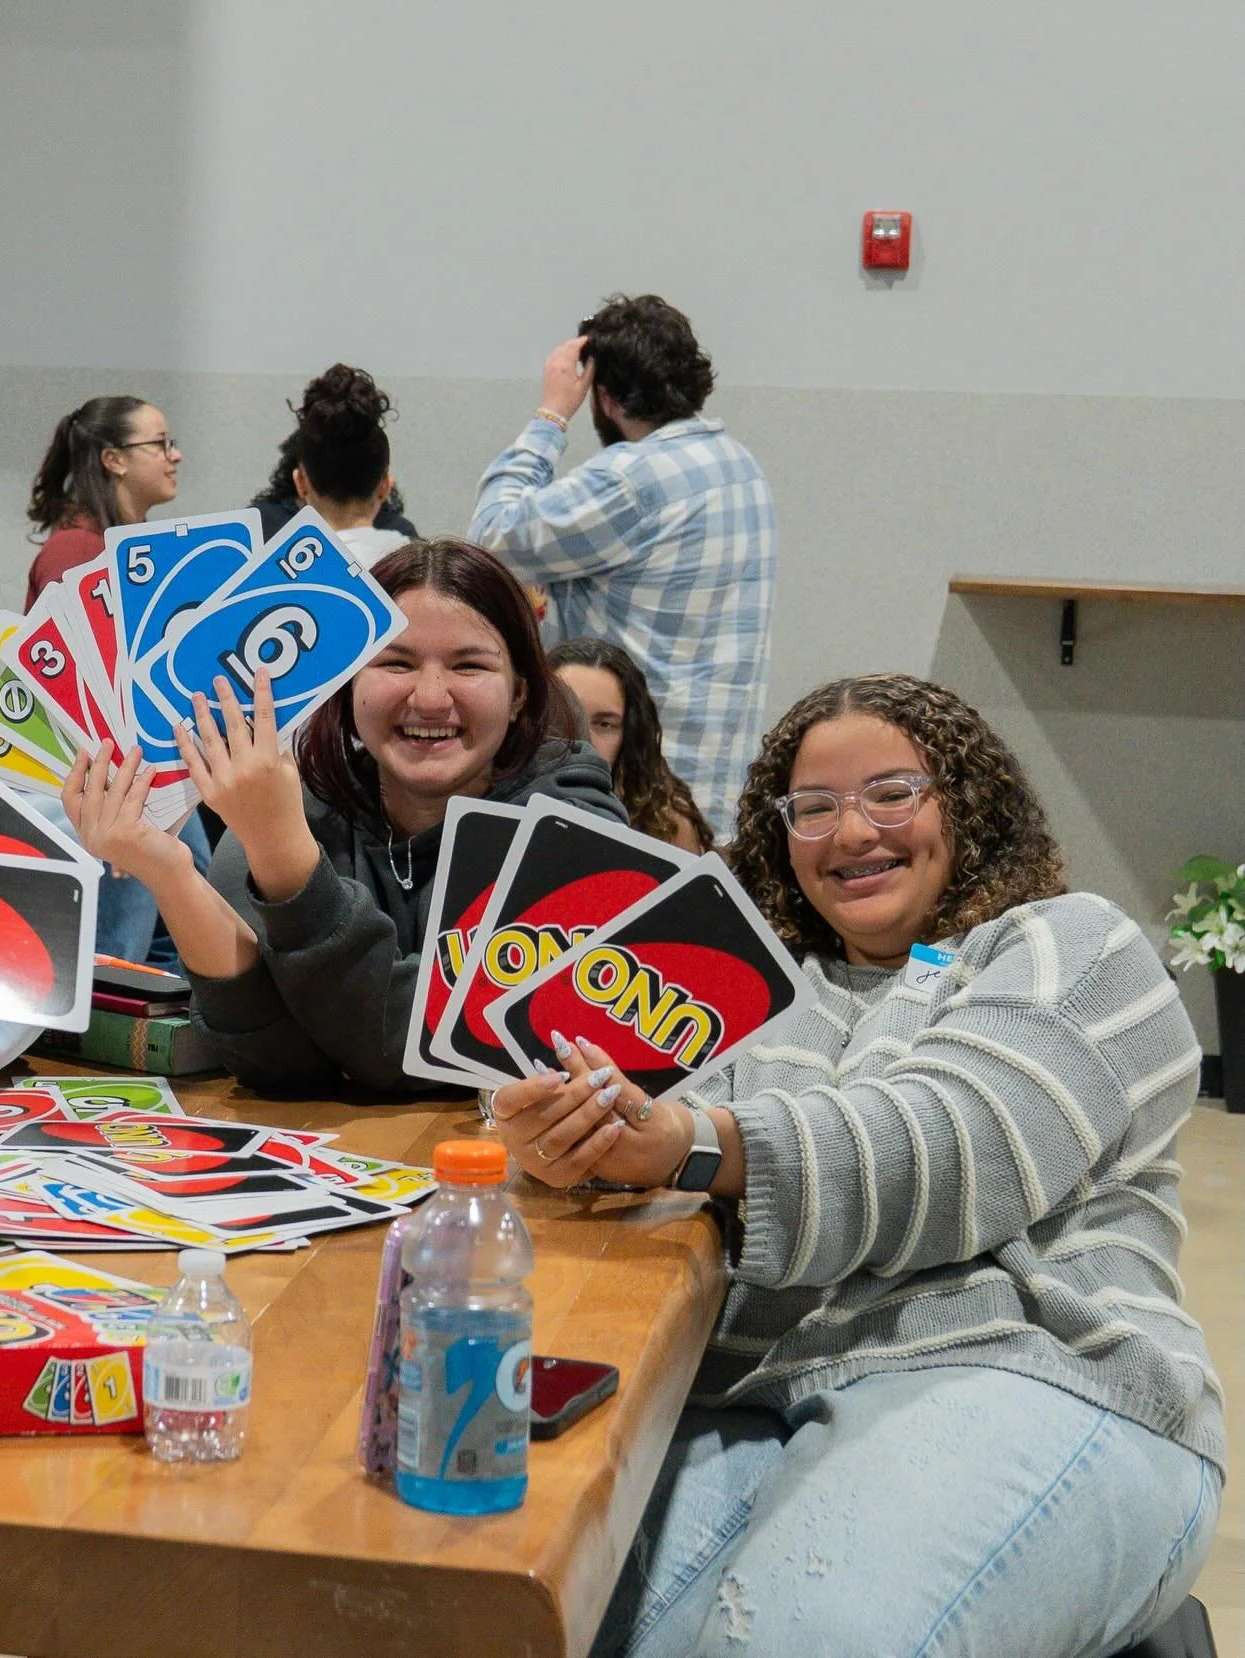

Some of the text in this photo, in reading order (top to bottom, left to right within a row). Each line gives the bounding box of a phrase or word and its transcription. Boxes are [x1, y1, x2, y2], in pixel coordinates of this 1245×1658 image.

[127, 544, 155, 584] 5
[30, 640, 65, 677] 3
[572, 943, 725, 1073] UNO
[103, 1375, 118, 1400] 1
[495, 1340, 531, 1412] G
